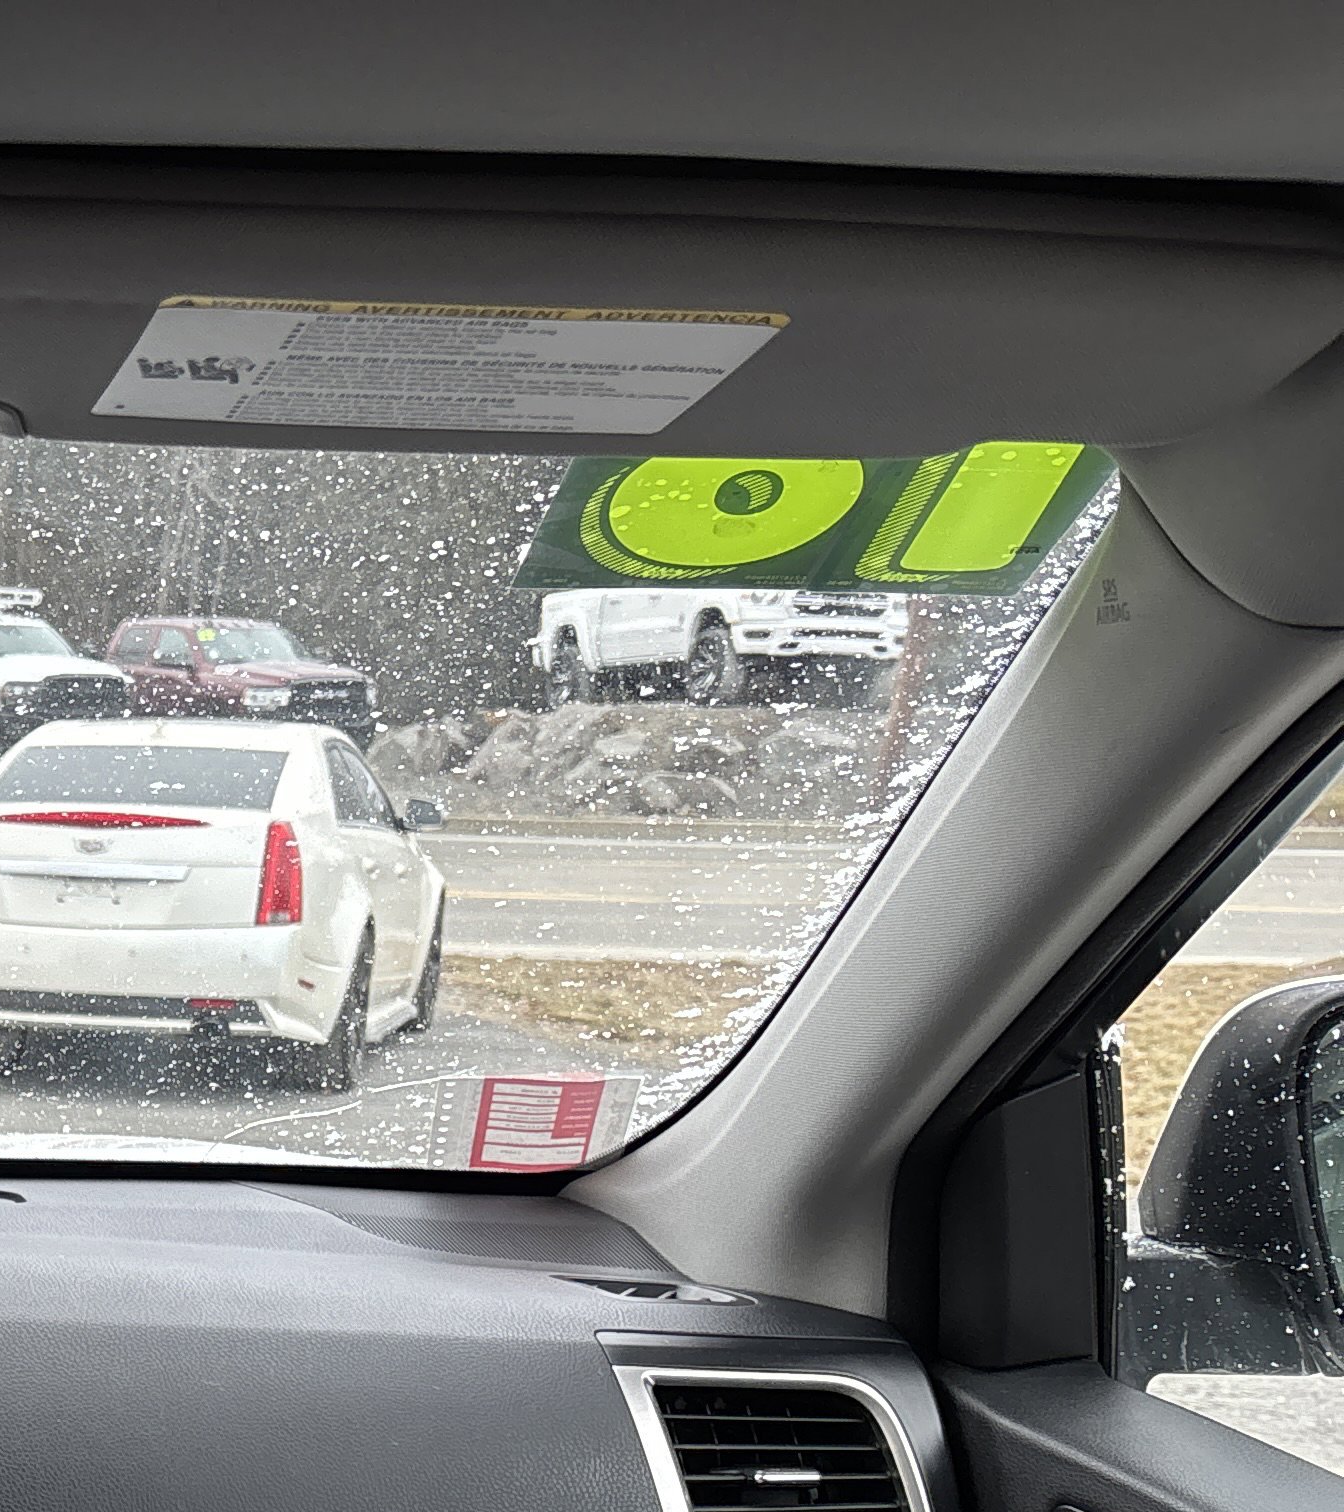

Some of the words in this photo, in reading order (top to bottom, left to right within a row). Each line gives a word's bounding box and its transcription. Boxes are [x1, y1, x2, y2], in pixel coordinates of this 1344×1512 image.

[212, 299, 330, 313] WARNING
[351, 304, 566, 319] AVERTISSEMENT
[585, 311, 772, 325] ADVERTENCIA
